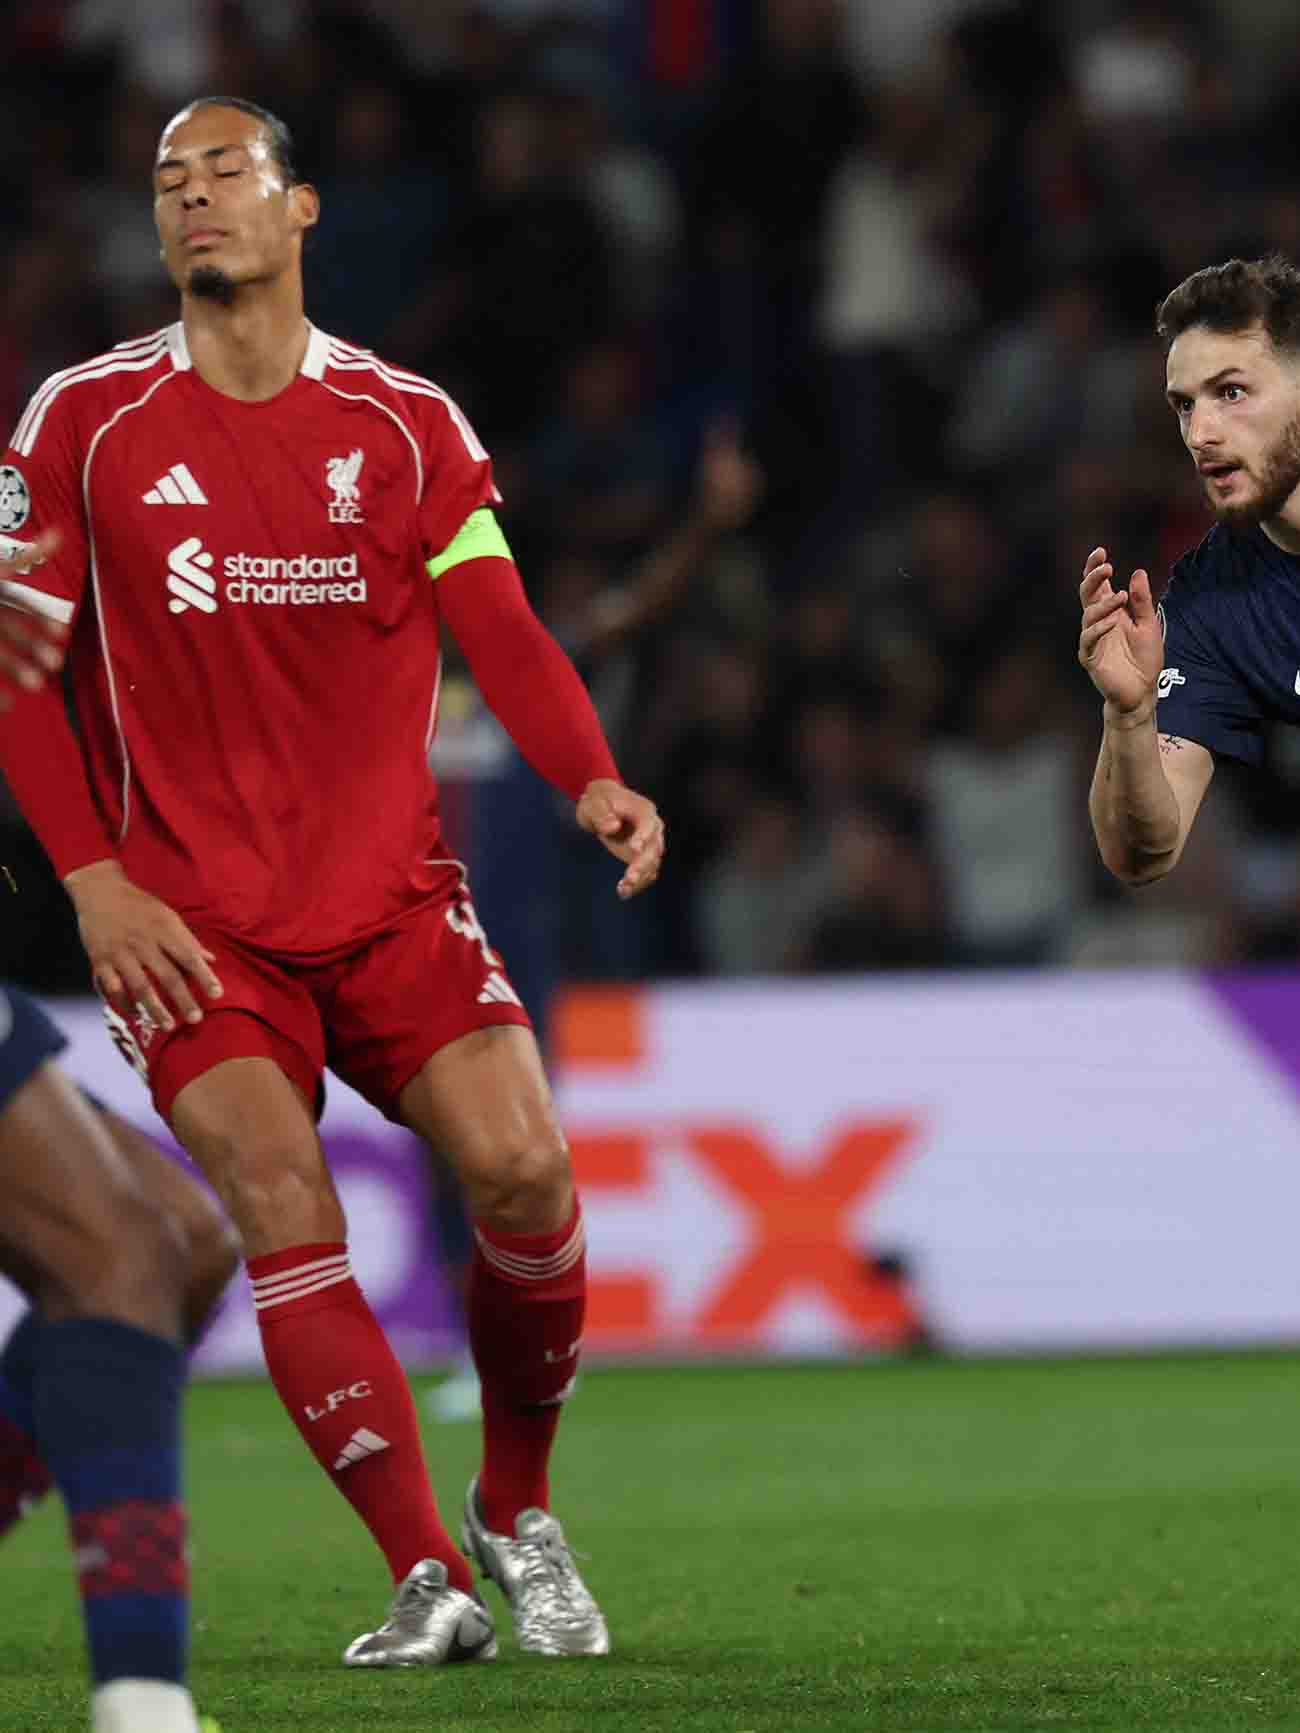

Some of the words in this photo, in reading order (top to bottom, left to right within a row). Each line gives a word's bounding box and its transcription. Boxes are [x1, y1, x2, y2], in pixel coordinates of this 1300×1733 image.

[223, 551, 358, 579] standard
[225, 577, 367, 605] chartered
[303, 1380, 373, 1422] LFC
